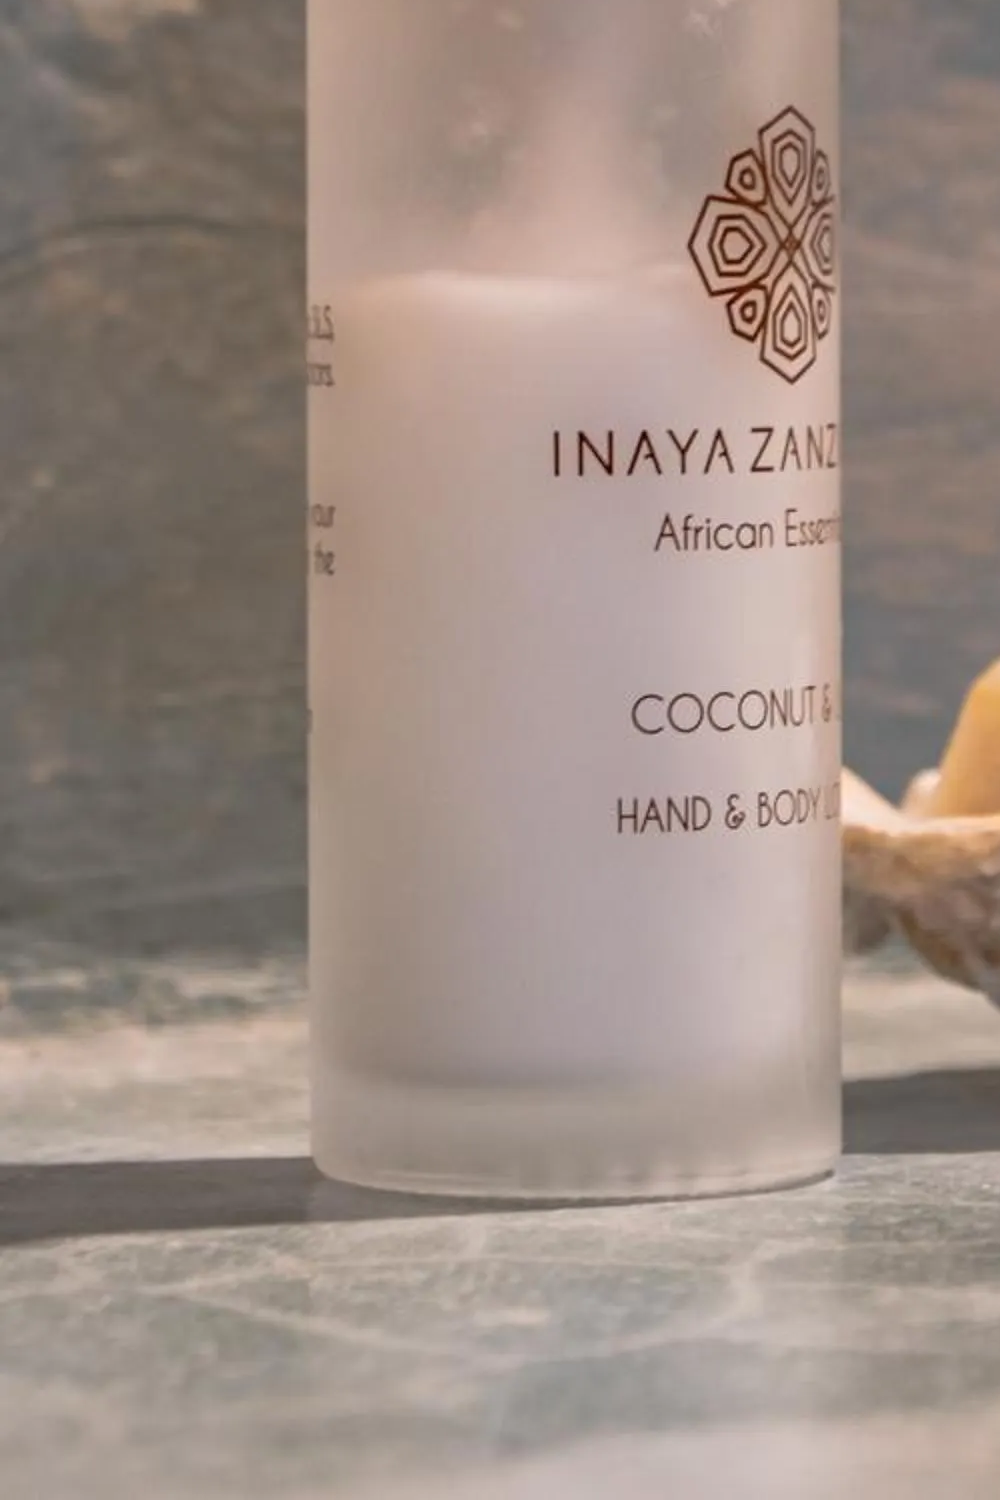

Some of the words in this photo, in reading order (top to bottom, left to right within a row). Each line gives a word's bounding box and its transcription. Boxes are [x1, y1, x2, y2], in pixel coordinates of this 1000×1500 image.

[552, 427, 735, 477] INAYA
[653, 511, 775, 552] African
[630, 684, 817, 736] COCONUT
[616, 795, 712, 835] HAND
[723, 792, 746, 830] &
[757, 787, 821, 829] BODY
